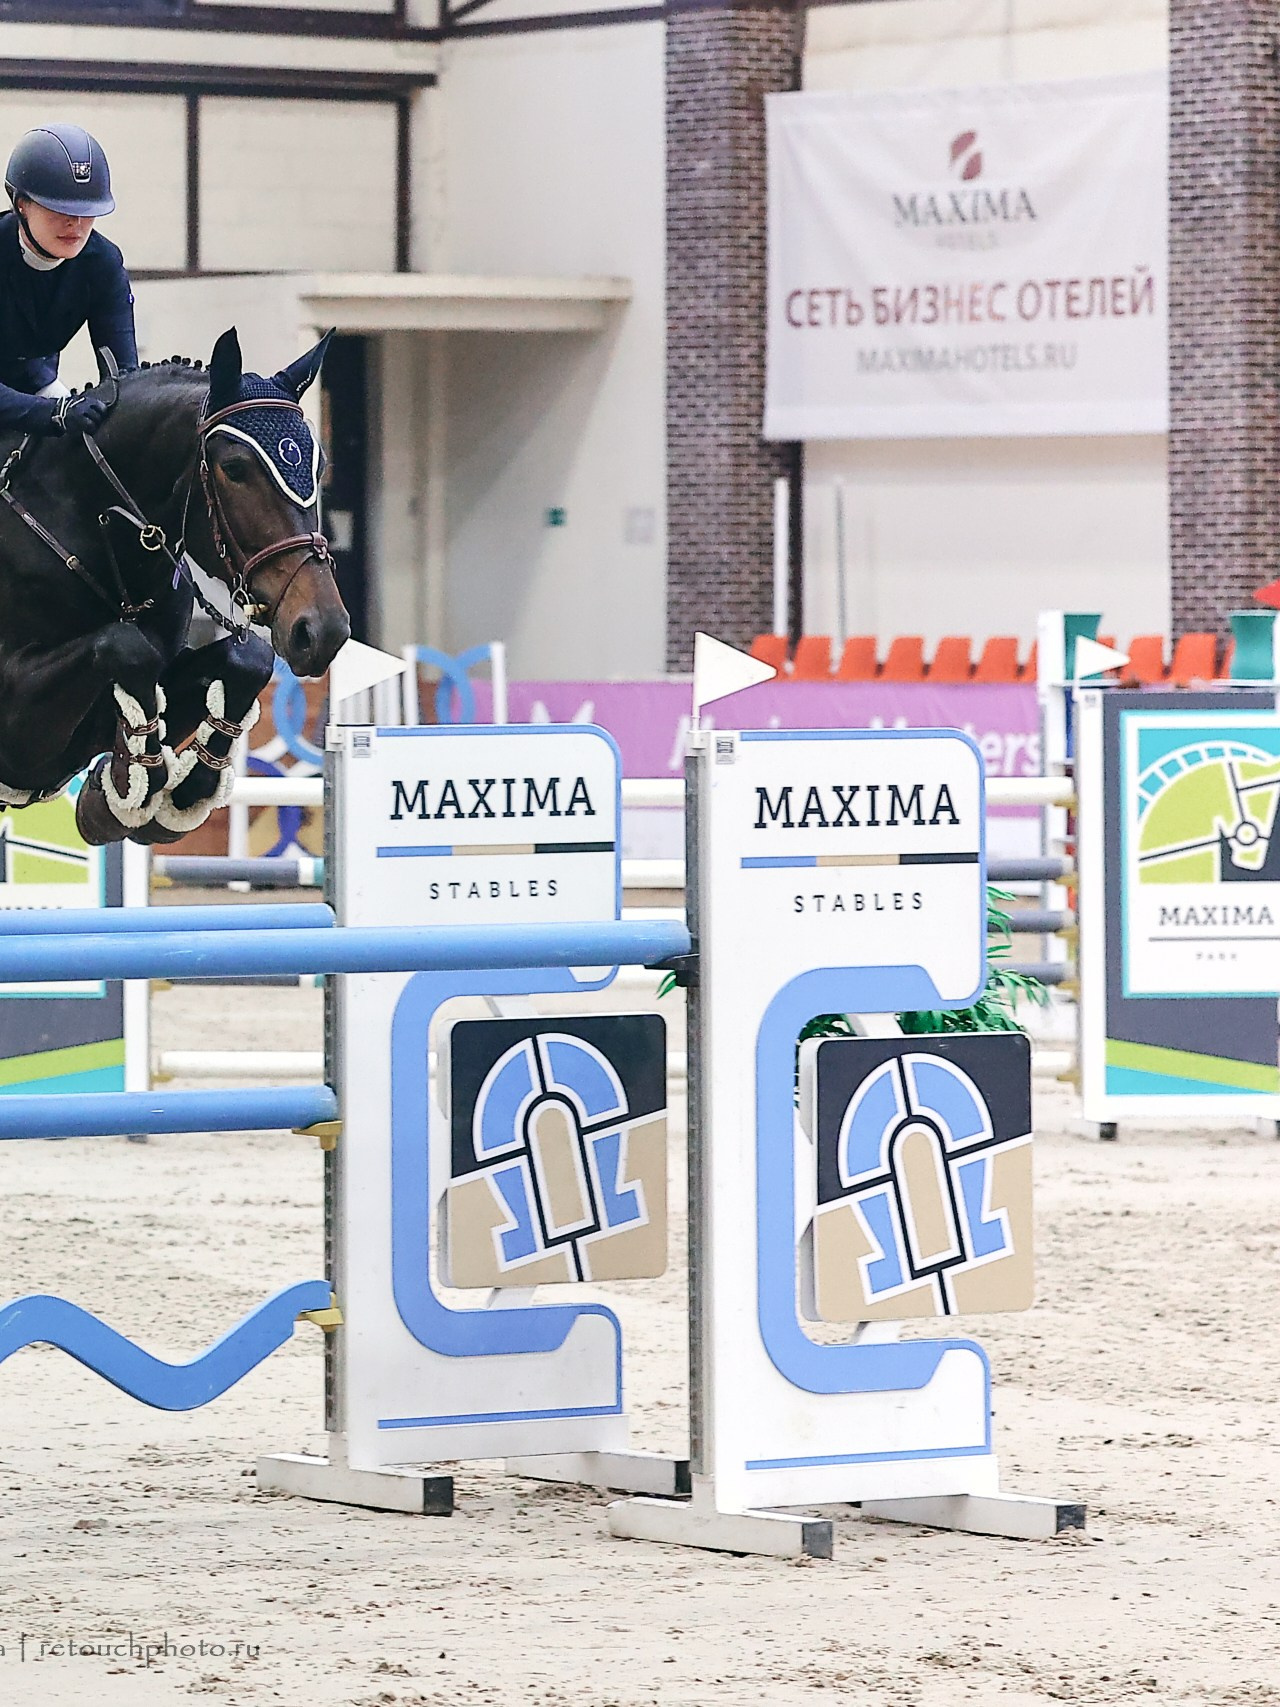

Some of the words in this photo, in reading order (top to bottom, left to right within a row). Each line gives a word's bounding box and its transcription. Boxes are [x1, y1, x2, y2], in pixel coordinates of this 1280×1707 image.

[892, 188, 1038, 228] MAXIMA
[785, 286, 865, 329] СЕТЬ
[871, 281, 1007, 326] БИЗНЕС
[1016, 264, 1155, 321] ОТЕЛЕЙ
[390, 776, 596, 821] MAXIMA
[754, 783, 960, 829] MAXIMA
[430, 879, 559, 900] STABLES
[794, 892, 923, 913] STABLES
[1159, 905, 1274, 926] MAXIMA
